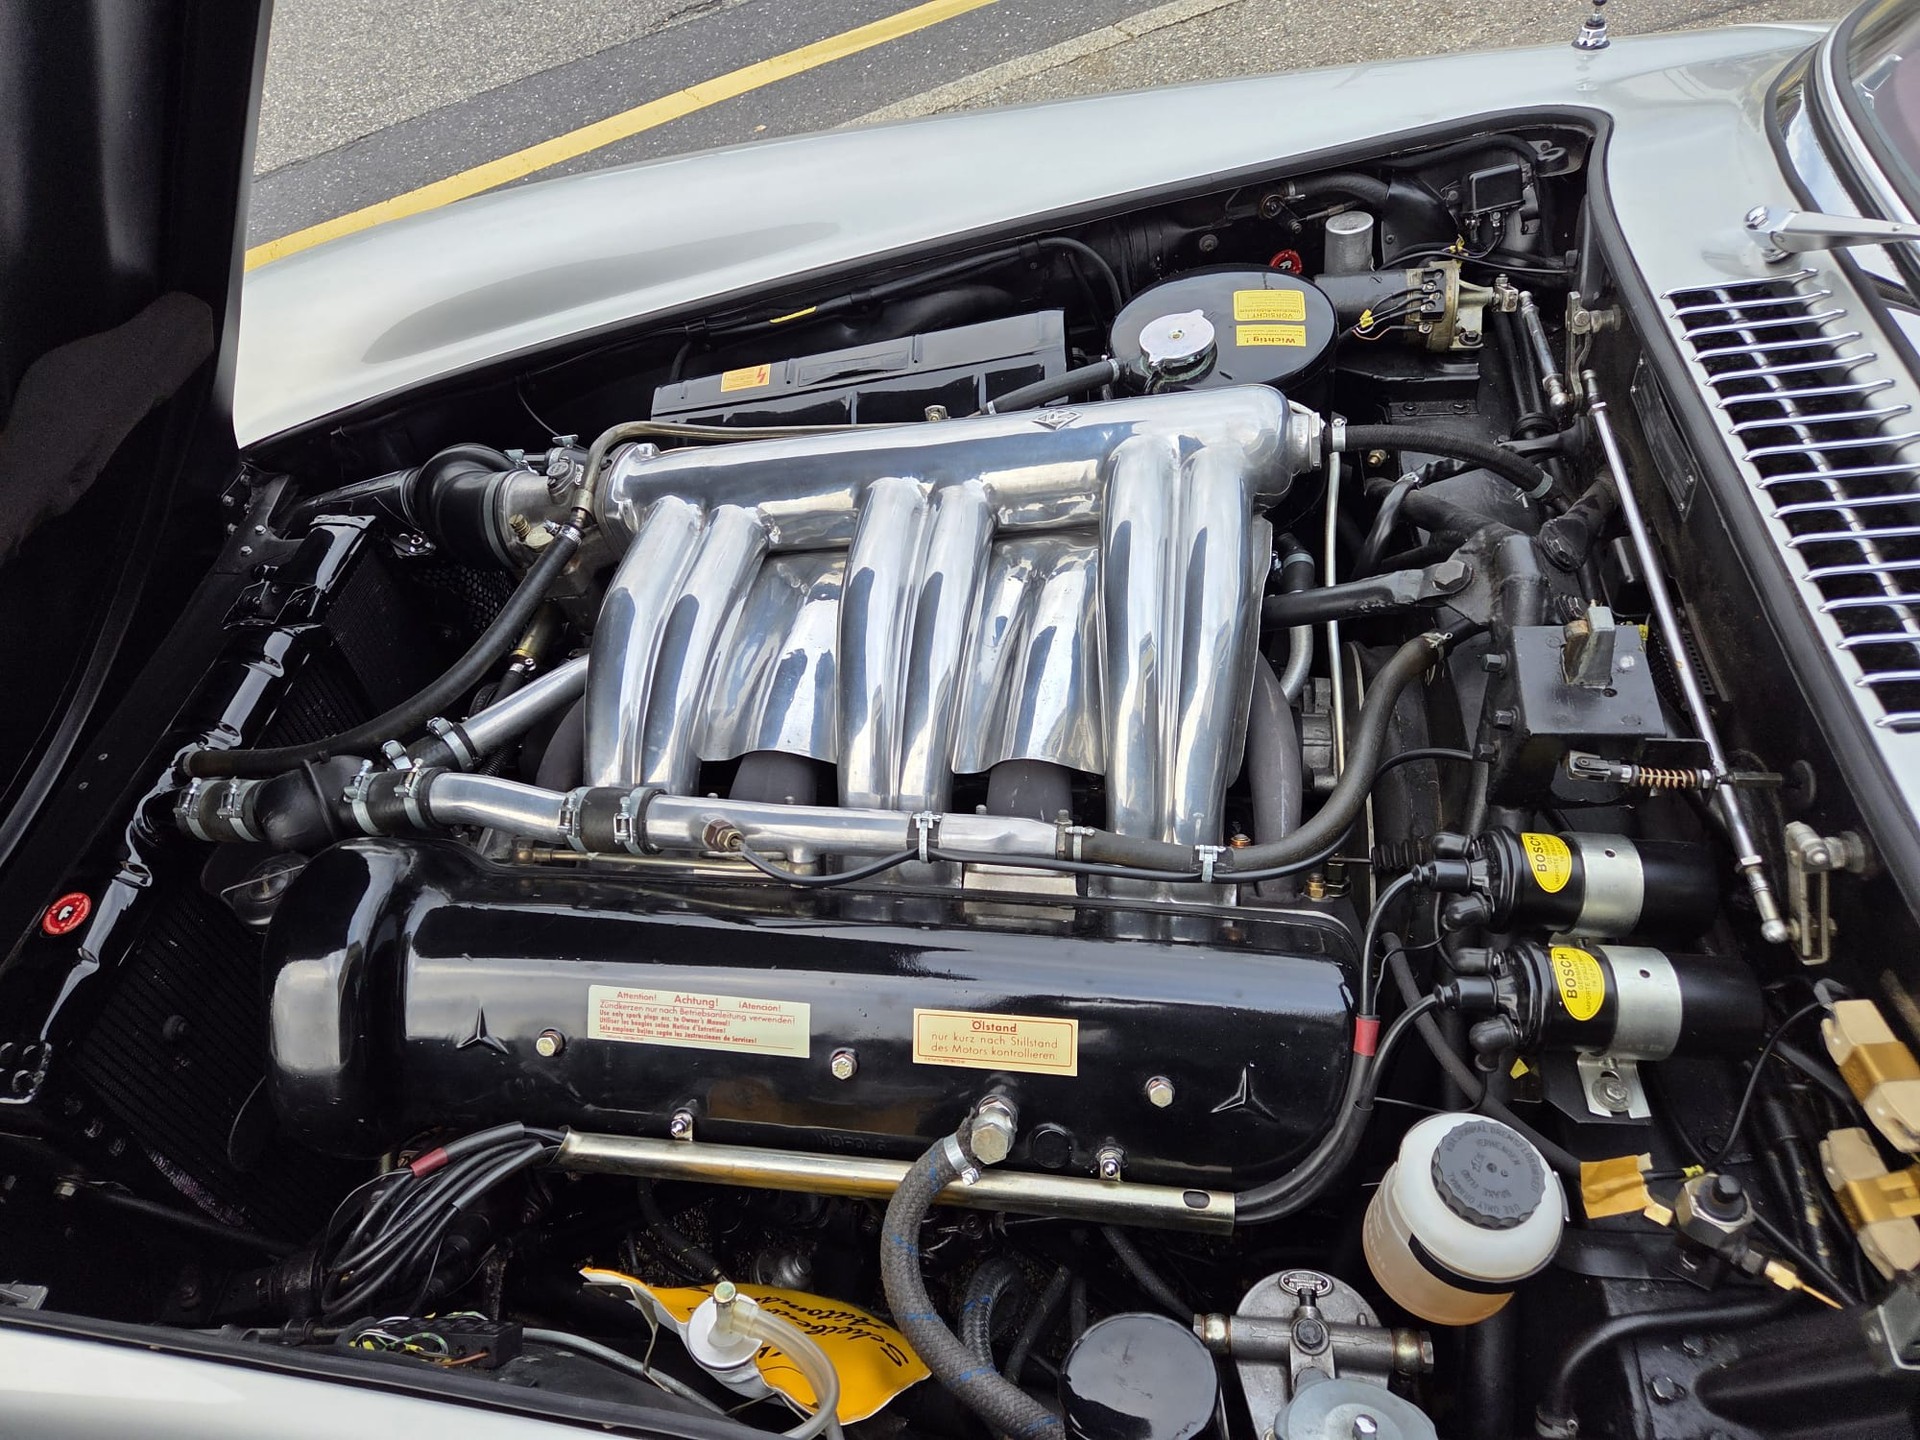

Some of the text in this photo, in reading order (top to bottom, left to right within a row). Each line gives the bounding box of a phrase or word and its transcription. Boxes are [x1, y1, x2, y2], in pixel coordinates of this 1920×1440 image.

[1253, 336, 1296, 344] Wichtig
[1527, 835, 1548, 872] BOSCH
[1556, 953, 1578, 999] BOSCH
[617, 991, 657, 1001] Attention!
[674, 994, 719, 1009] Achtung!
[600, 1001, 644, 1011] Zündkerzen
[659, 1006, 678, 1014] nach
[971, 1020, 1018, 1032] Ölstand
[931, 1032, 1058, 1049] nur kurz nach Stillstand
[931, 1042, 949, 1052] des
[952, 1045, 988, 1055] Motors
